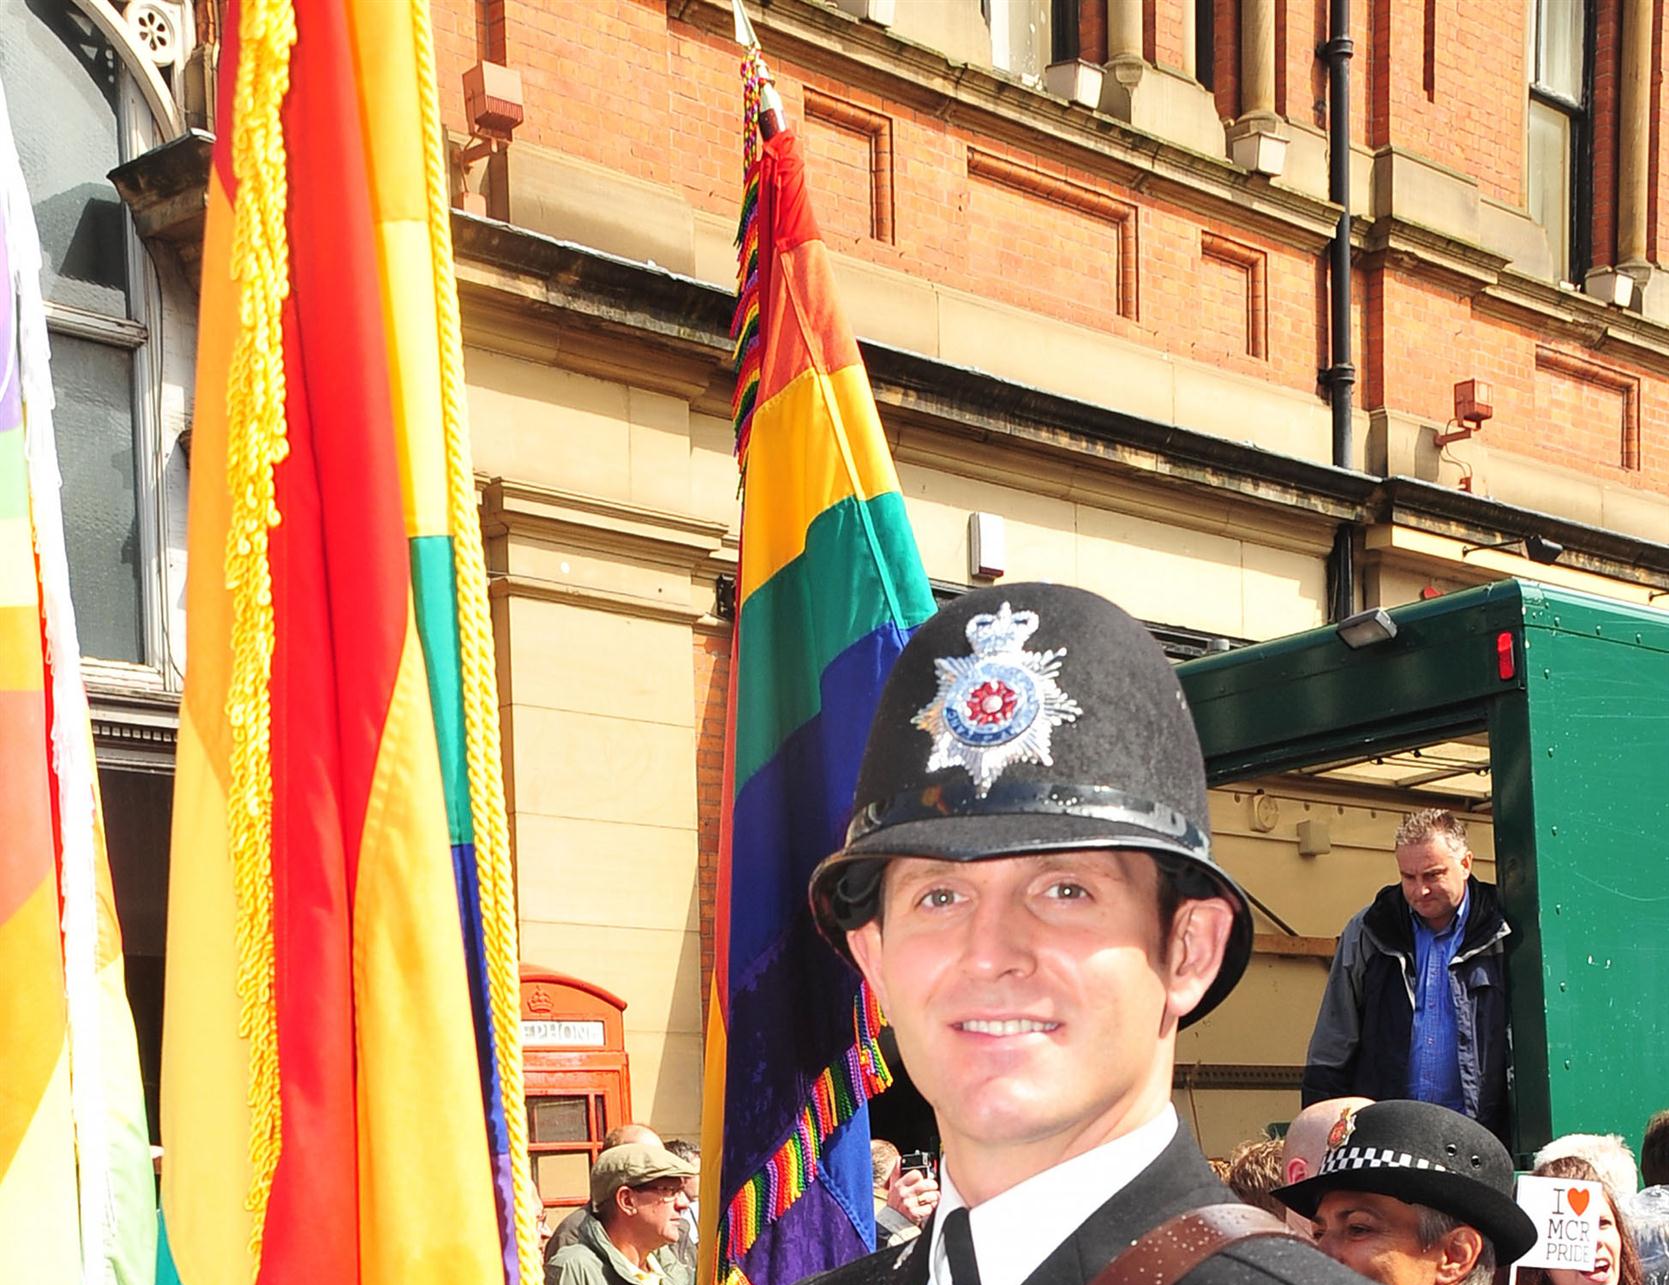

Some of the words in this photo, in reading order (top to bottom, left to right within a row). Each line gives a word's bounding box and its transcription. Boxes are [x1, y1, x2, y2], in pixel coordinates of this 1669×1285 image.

[1552, 1187, 1565, 1215] I
[1547, 1219, 1590, 1242] MCR
[1545, 1243, 1590, 1263] PRIDE
